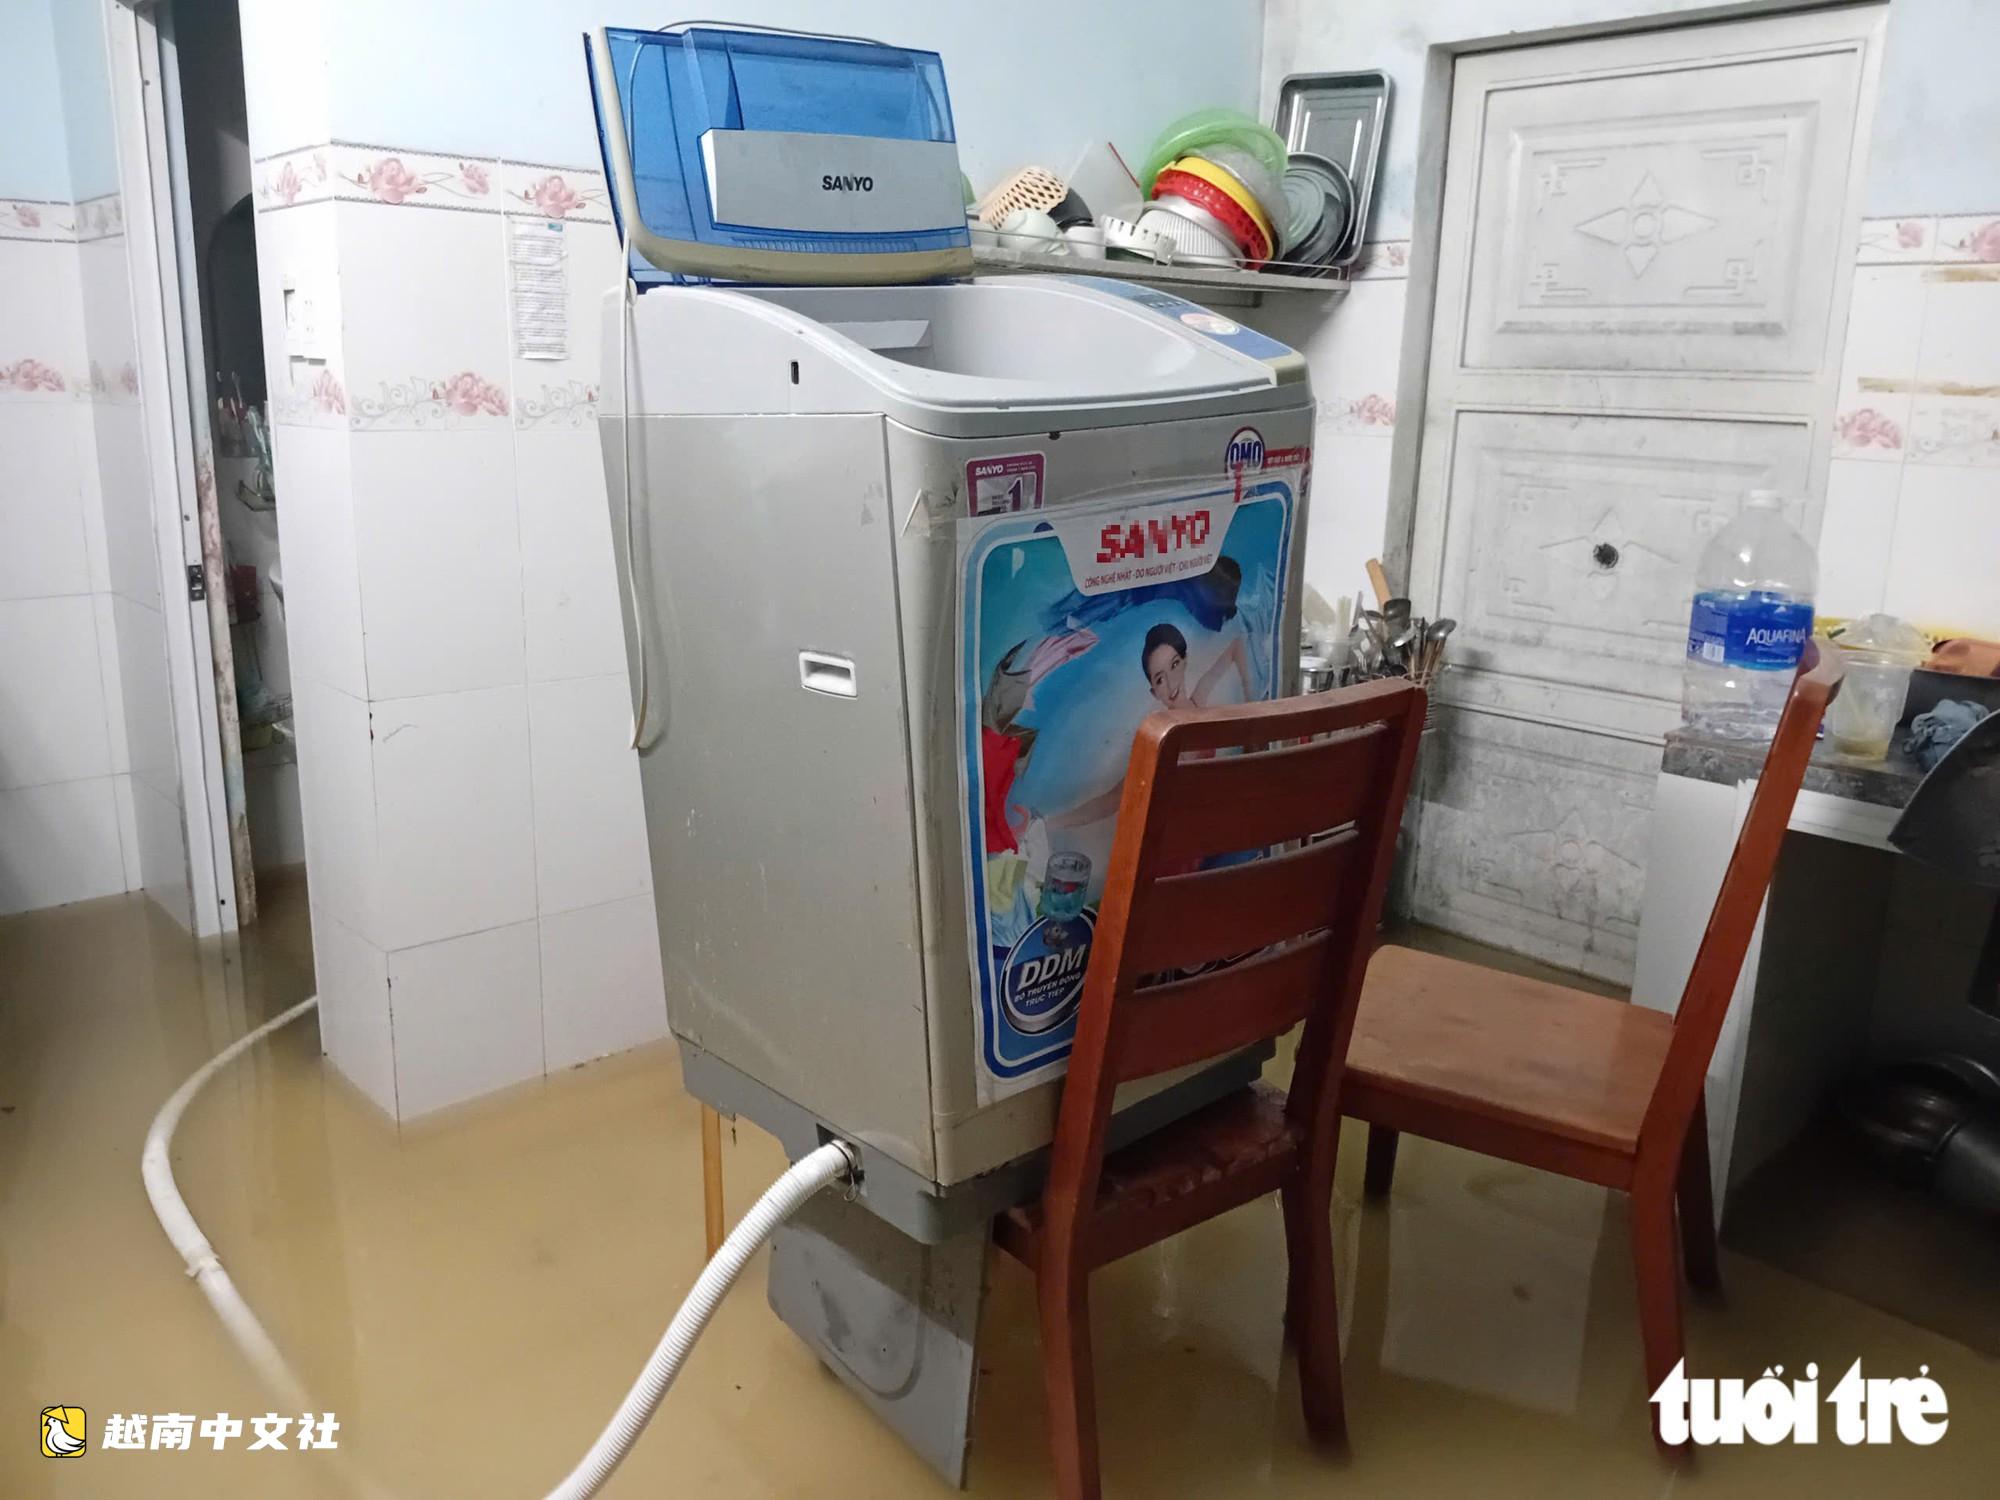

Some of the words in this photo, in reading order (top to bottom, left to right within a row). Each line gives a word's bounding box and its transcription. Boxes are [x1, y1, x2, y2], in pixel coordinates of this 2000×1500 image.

[822, 175, 874, 192] SANYO
[1230, 441, 1262, 470] OMO
[975, 464, 1004, 476] SANYO
[1097, 510, 1210, 563] SANYO
[1746, 627, 1807, 647] AQUAFINA
[1016, 944, 1087, 992] DDM
